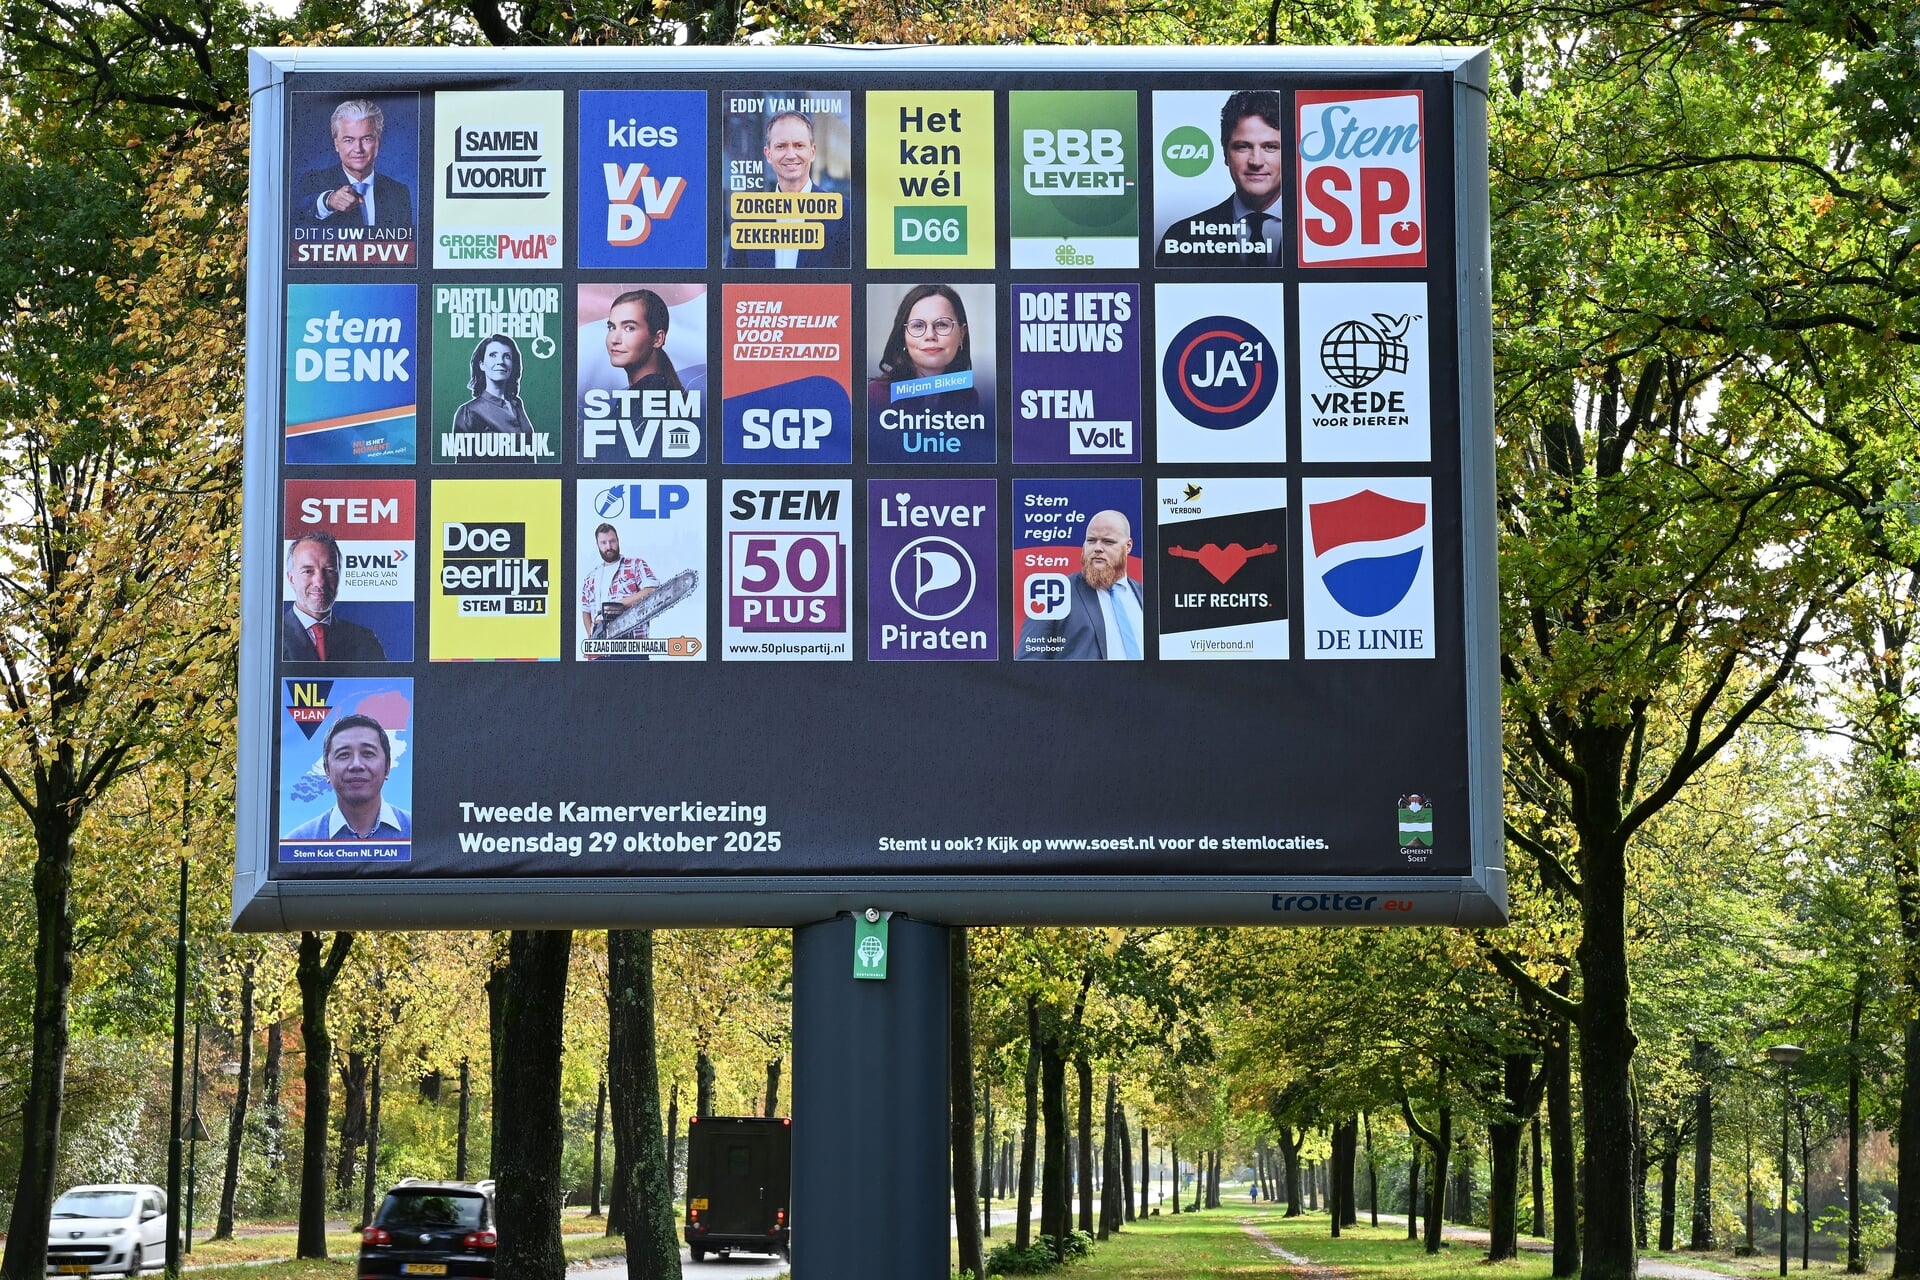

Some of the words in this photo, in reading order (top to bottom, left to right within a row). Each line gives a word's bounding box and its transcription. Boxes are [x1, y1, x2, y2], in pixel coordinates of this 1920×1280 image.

[730, 98, 764, 113] EDDY
[769, 98, 795, 113] VAN
[800, 98, 842, 113] HIJUM
[900, 107, 962, 133] Het
[465, 131, 538, 152] SAMEN
[608, 118, 678, 147] kies
[1300, 105, 1421, 162] Stem
[900, 139, 961, 165] kan
[1023, 129, 1125, 166] BBB
[1166, 144, 1209, 159] CDA
[457, 167, 546, 188] VOORUIT
[730, 161, 763, 174] STEM
[900, 170, 961, 197] wél
[1029, 171, 1124, 189] LEVERT
[736, 199, 792, 213] ZORGEN
[797, 199, 837, 213] VOOR
[294, 228, 317, 240] DIT
[320, 228, 334, 240] IS
[338, 228, 364, 240] UW
[368, 228, 412, 241] LAND!
[736, 228, 819, 244] ZEKERHEID!
[901, 218, 960, 243] D66
[1190, 219, 1246, 236] Henri
[298, 244, 358, 262] STEM
[363, 244, 409, 262] PVV
[440, 234, 497, 247] GROEN
[498, 234, 548, 260] PvdA
[449, 247, 497, 260] LINKS
[1165, 238, 1273, 254] Bontenbal
[1066, 254, 1095, 266] BBB
[437, 288, 504, 314] PARTIJ
[508, 288, 558, 313] VOOR
[736, 301, 783, 314] STEM
[1019, 292, 1069, 321] DOE
[1074, 292, 1131, 321] IETS
[303, 310, 402, 343] stem
[451, 313, 475, 338] DE
[479, 313, 544, 338] DIEREN
[736, 315, 839, 328] CHRISTELIJK
[736, 330, 783, 342] VOOR
[1019, 323, 1123, 352] NIEUWS
[736, 346, 838, 358] NEDERLAND
[296, 348, 410, 382] DENK
[896, 381, 932, 395] Mirjam
[934, 375, 967, 388] Bikker
[583, 390, 700, 419] STEM
[1021, 390, 1095, 419] STEM
[1311, 391, 1405, 414] VREDE
[742, 408, 833, 449] SGP
[879, 409, 985, 430] Christen
[1312, 416, 1349, 427] VOOR
[1353, 415, 1409, 426] DIEREN
[353, 442, 389, 455] MOMENT
[441, 433, 555, 457] NATUURLIJK.
[583, 420, 700, 458] FVD
[903, 432, 961, 453] Unie
[1077, 428, 1126, 449] Volt
[300, 498, 398, 524] STEM
[629, 484, 690, 519] LP
[729, 489, 840, 520] STEM
[881, 493, 986, 527] Liever
[1024, 494, 1069, 507] Stem
[1163, 498, 1178, 506] VRIJ
[1024, 512, 1062, 523] voor
[1065, 510, 1085, 523] de
[443, 522, 511, 552] Doe
[1024, 527, 1073, 541] regio!
[345, 555, 397, 568] BVNL
[741, 537, 830, 593] 50
[1024, 554, 1069, 567] Stem
[345, 579, 398, 587] NEDERLAND
[441, 558, 549, 596] eerlijk.
[463, 600, 501, 612] STEM
[513, 600, 543, 612] BIJ1
[743, 599, 826, 623] PLUS
[1175, 594, 1207, 608] LIEF
[1210, 593, 1273, 608] RECHTS.
[584, 641, 593, 653] DE
[593, 641, 610, 653] ZAAG
[611, 641, 627, 653] DOOR
[629, 641, 641, 653] DEN
[641, 641, 668, 653] HAAG.NL
[881, 624, 987, 650] Piraten
[1025, 636, 1046, 644] Aant
[1047, 636, 1066, 644] Jelle
[1190, 639, 1254, 651] VrijVerbond.nl
[1317, 630, 1350, 650] DE
[1358, 629, 1424, 650] LINIE
[729, 642, 845, 656] www.50pluspartij.nl
[1025, 645, 1064, 653] Soepboer
[294, 683, 325, 707] NL
[293, 710, 325, 720] PLAN
[459, 802, 552, 823] Tweede
[559, 801, 767, 827] Kamerverkiezing
[294, 849, 316, 857] Stem
[317, 849, 334, 857] Kok
[336, 849, 359, 857] Chan
[360, 849, 373, 857] NL
[374, 849, 398, 857] PLAN
[458, 832, 582, 857] Woensdag
[588, 831, 617, 852] 29
[623, 831, 718, 852] oktober
[724, 831, 782, 852] 2025
[878, 836, 928, 851] Stemt
[931, 840, 941, 851] u
[944, 836, 983, 851] ook?
[987, 836, 1019, 853] Kijk
[1022, 839, 1042, 853] op
[1044, 836, 1155, 850] www.soest.nl
[1159, 838, 1196, 850] voor
[1199, 836, 1218, 850] de
[1222, 836, 1329, 850] stemlocaties.
[1271, 893, 1413, 912] trotter.eu
